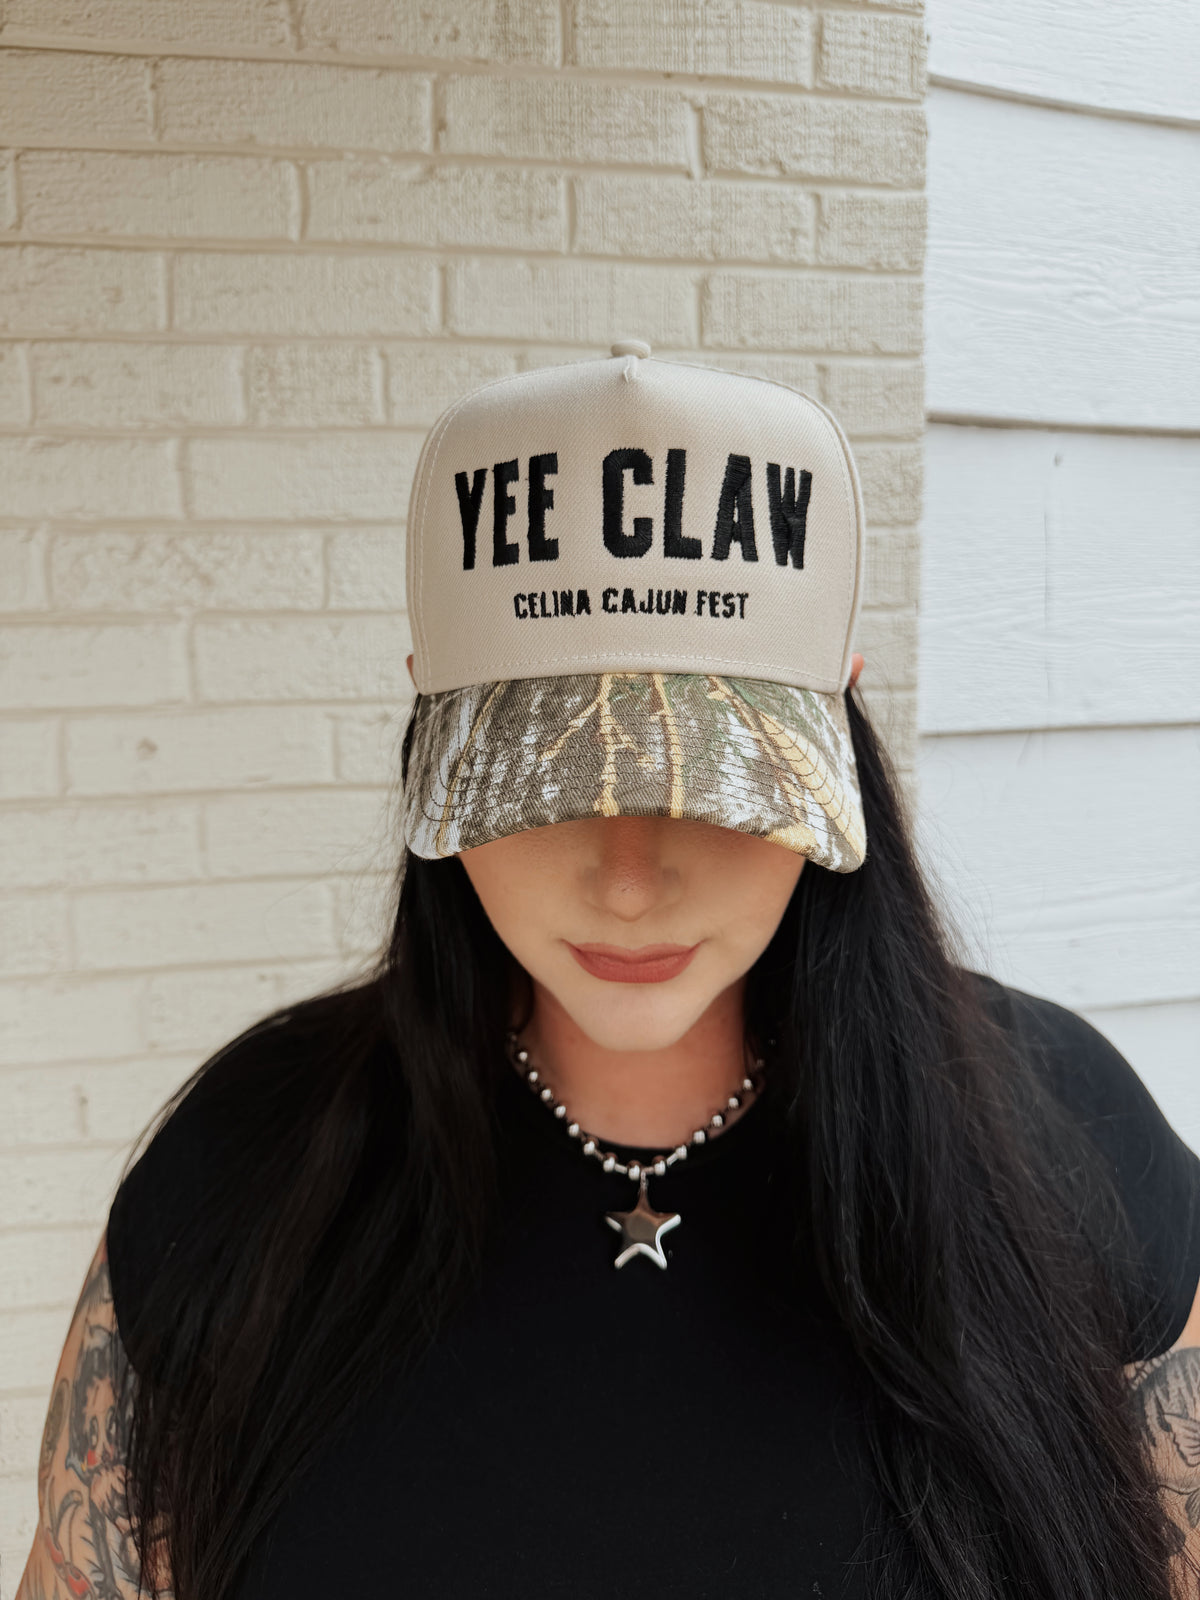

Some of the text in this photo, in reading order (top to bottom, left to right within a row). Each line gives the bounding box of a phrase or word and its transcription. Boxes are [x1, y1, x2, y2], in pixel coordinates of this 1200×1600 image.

[454, 447, 813, 571] YEE CLAW
[513, 587, 749, 620] CELINA CAJUN FEST
